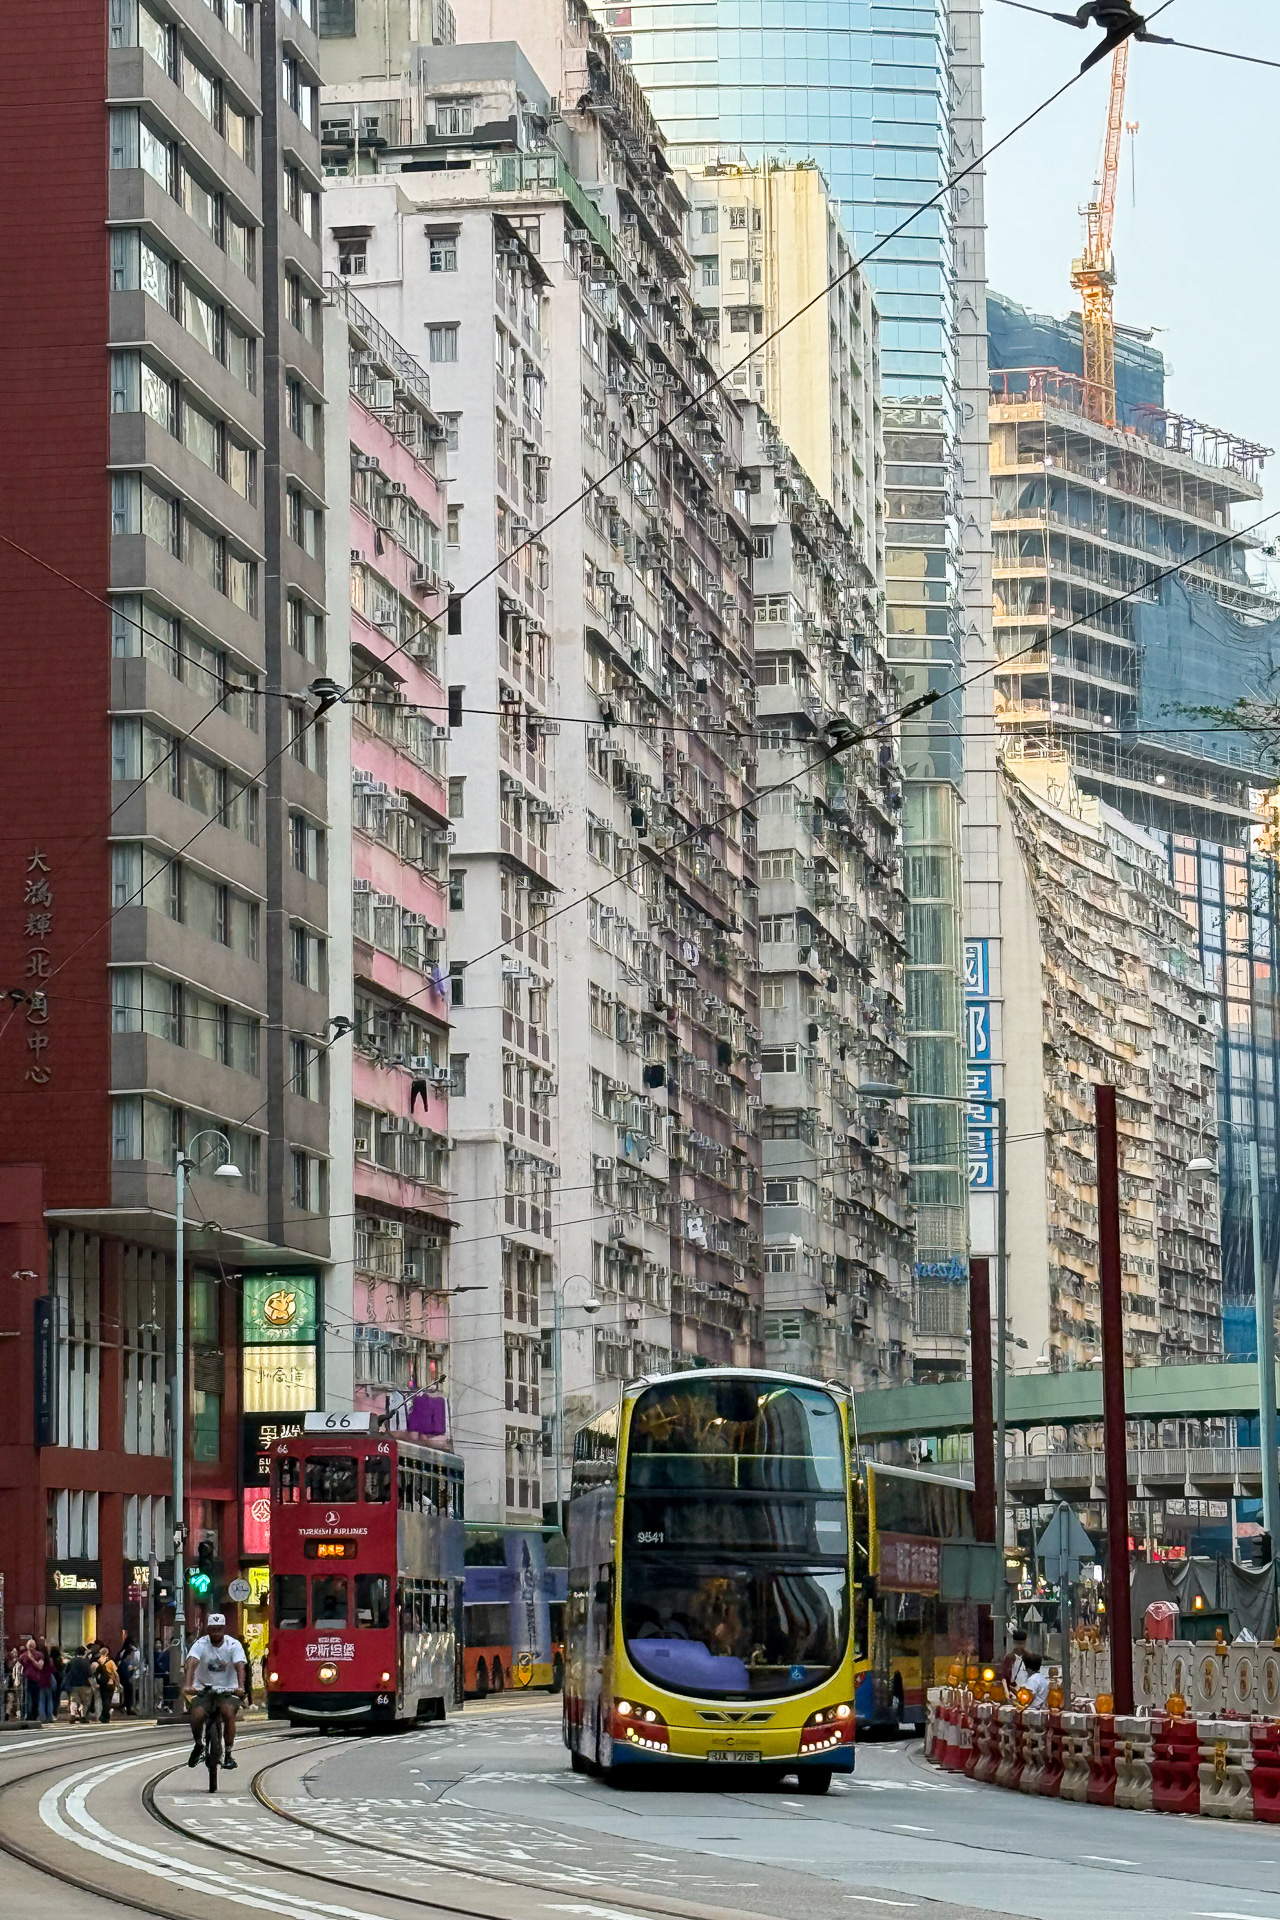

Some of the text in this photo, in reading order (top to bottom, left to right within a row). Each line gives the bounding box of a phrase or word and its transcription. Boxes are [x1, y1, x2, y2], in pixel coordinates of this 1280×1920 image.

[960, 402, 987, 647] PLAZA
[325, 1412, 351, 1428] 66
[277, 1444, 289, 1455] 66
[377, 1442, 390, 1454] 66
[298, 1527, 368, 1535] TURKISH AIRLINES
[305, 1643, 355, 1658] 伊斯坦堡
[376, 1694, 390, 1706] 66
